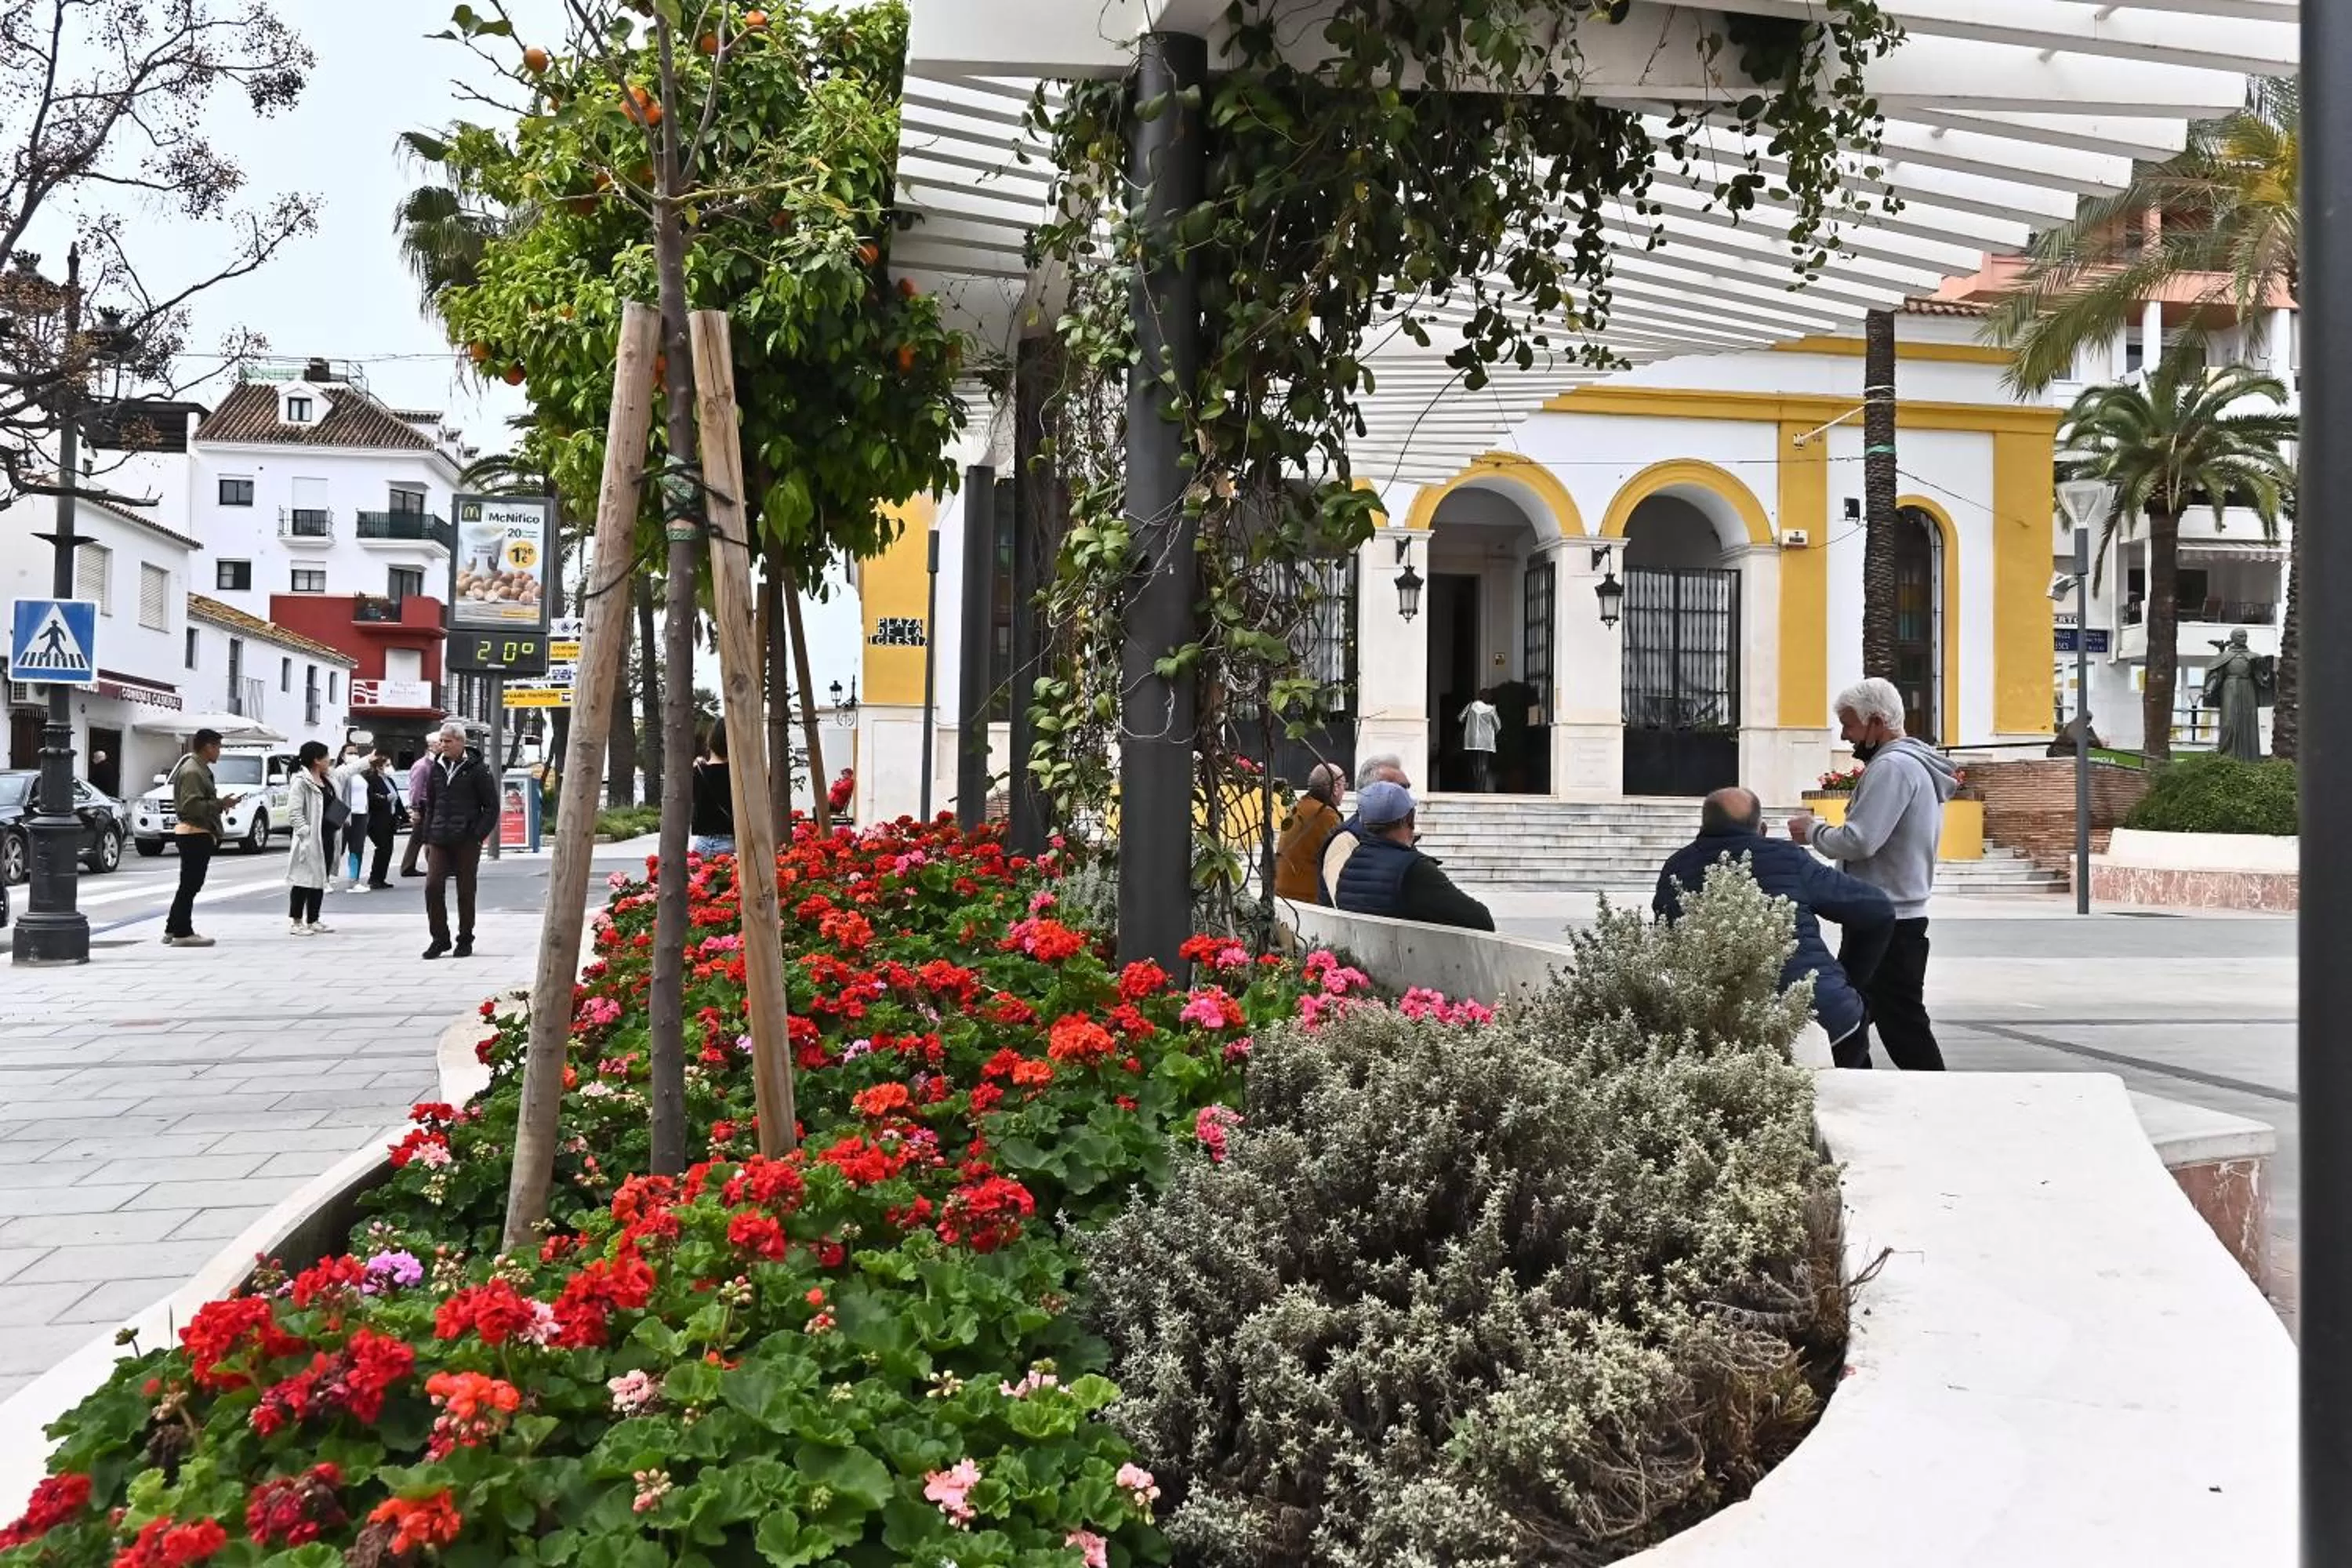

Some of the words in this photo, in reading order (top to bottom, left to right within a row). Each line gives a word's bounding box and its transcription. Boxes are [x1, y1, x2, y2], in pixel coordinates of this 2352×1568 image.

[507, 528, 521, 538] 20
[877, 617, 922, 627] PLAZA
[877, 627, 894, 636] DE
[905, 627, 921, 637] LA
[122, 687, 151, 701] COMIDAS
